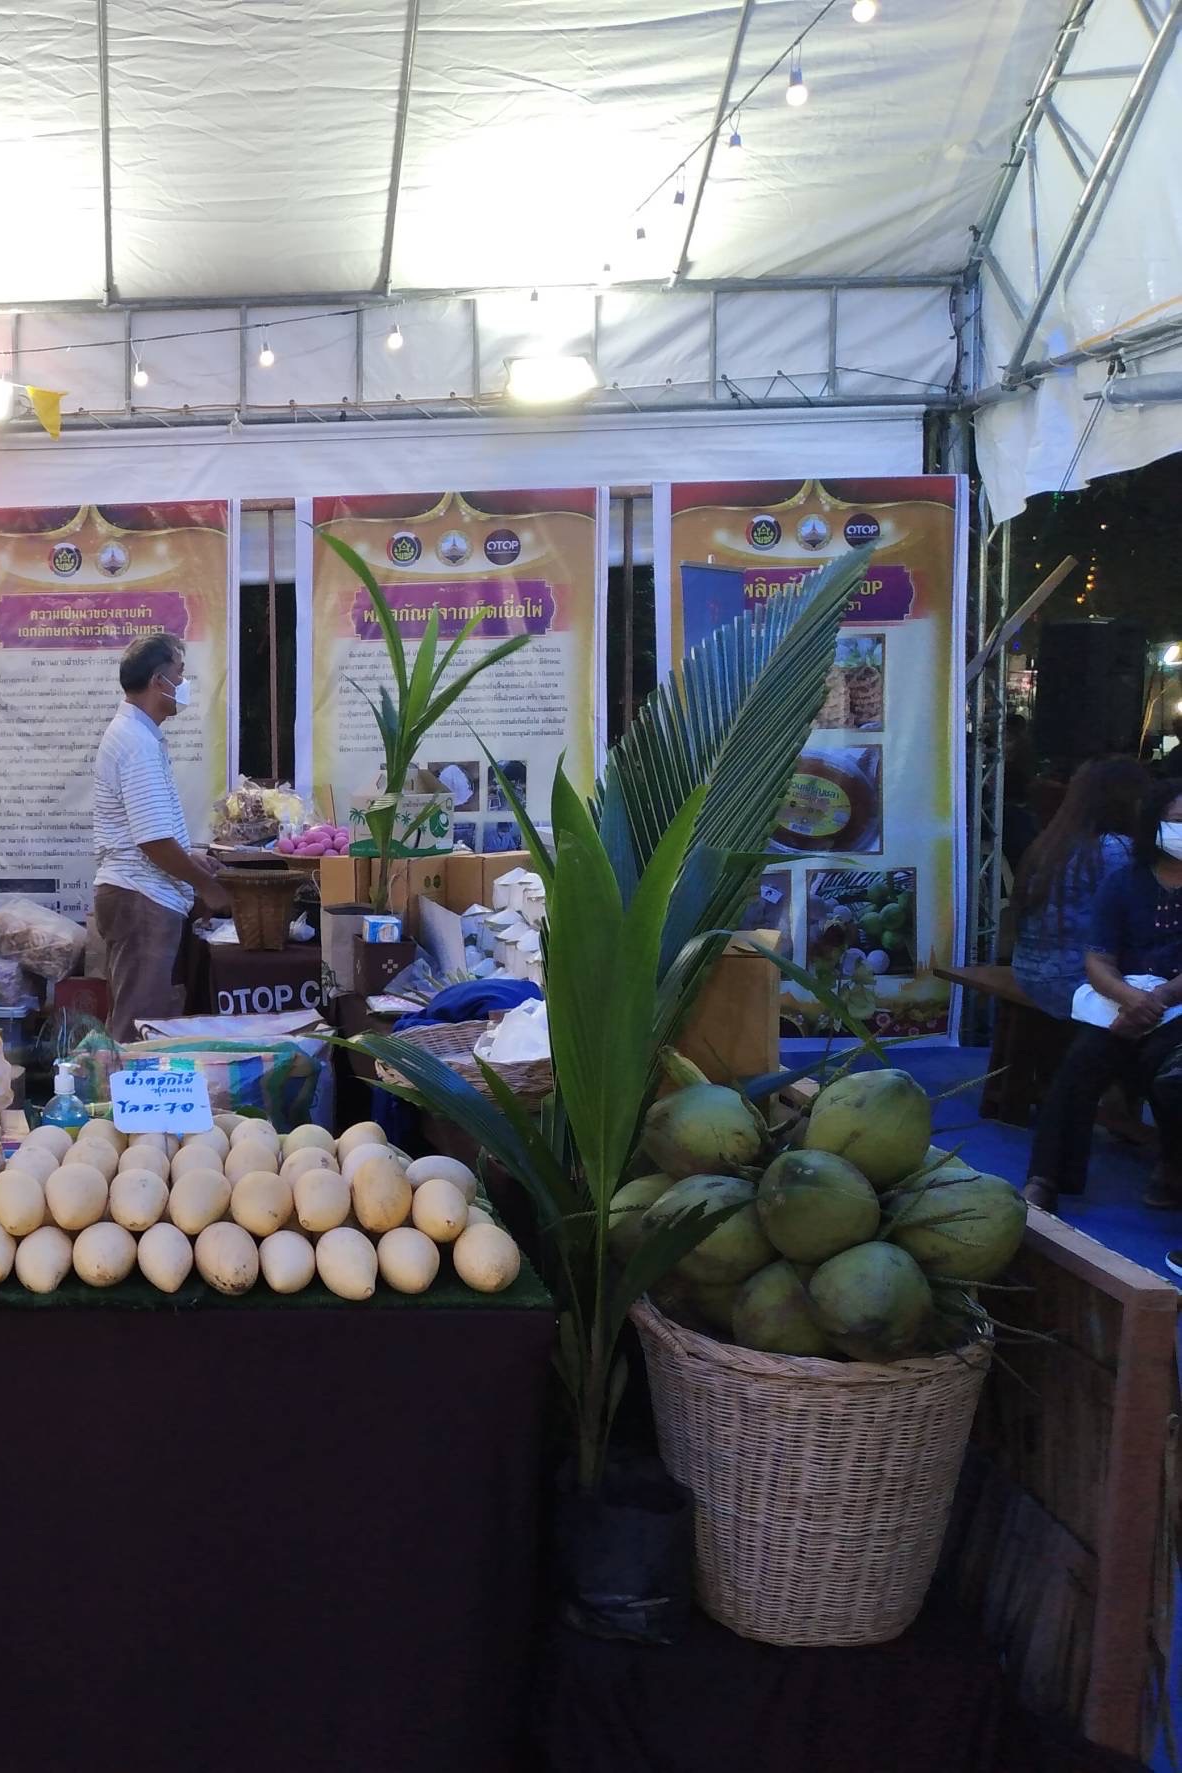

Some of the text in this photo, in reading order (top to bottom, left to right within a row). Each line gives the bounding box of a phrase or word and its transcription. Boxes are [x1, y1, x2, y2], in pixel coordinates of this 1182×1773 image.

[846, 524, 878, 535] OTOP
[487, 540, 518, 550] OTOP
[30, 604, 152, 621] ความเป็นมาของลายผ้า
[218, 984, 293, 1015] OTOP
